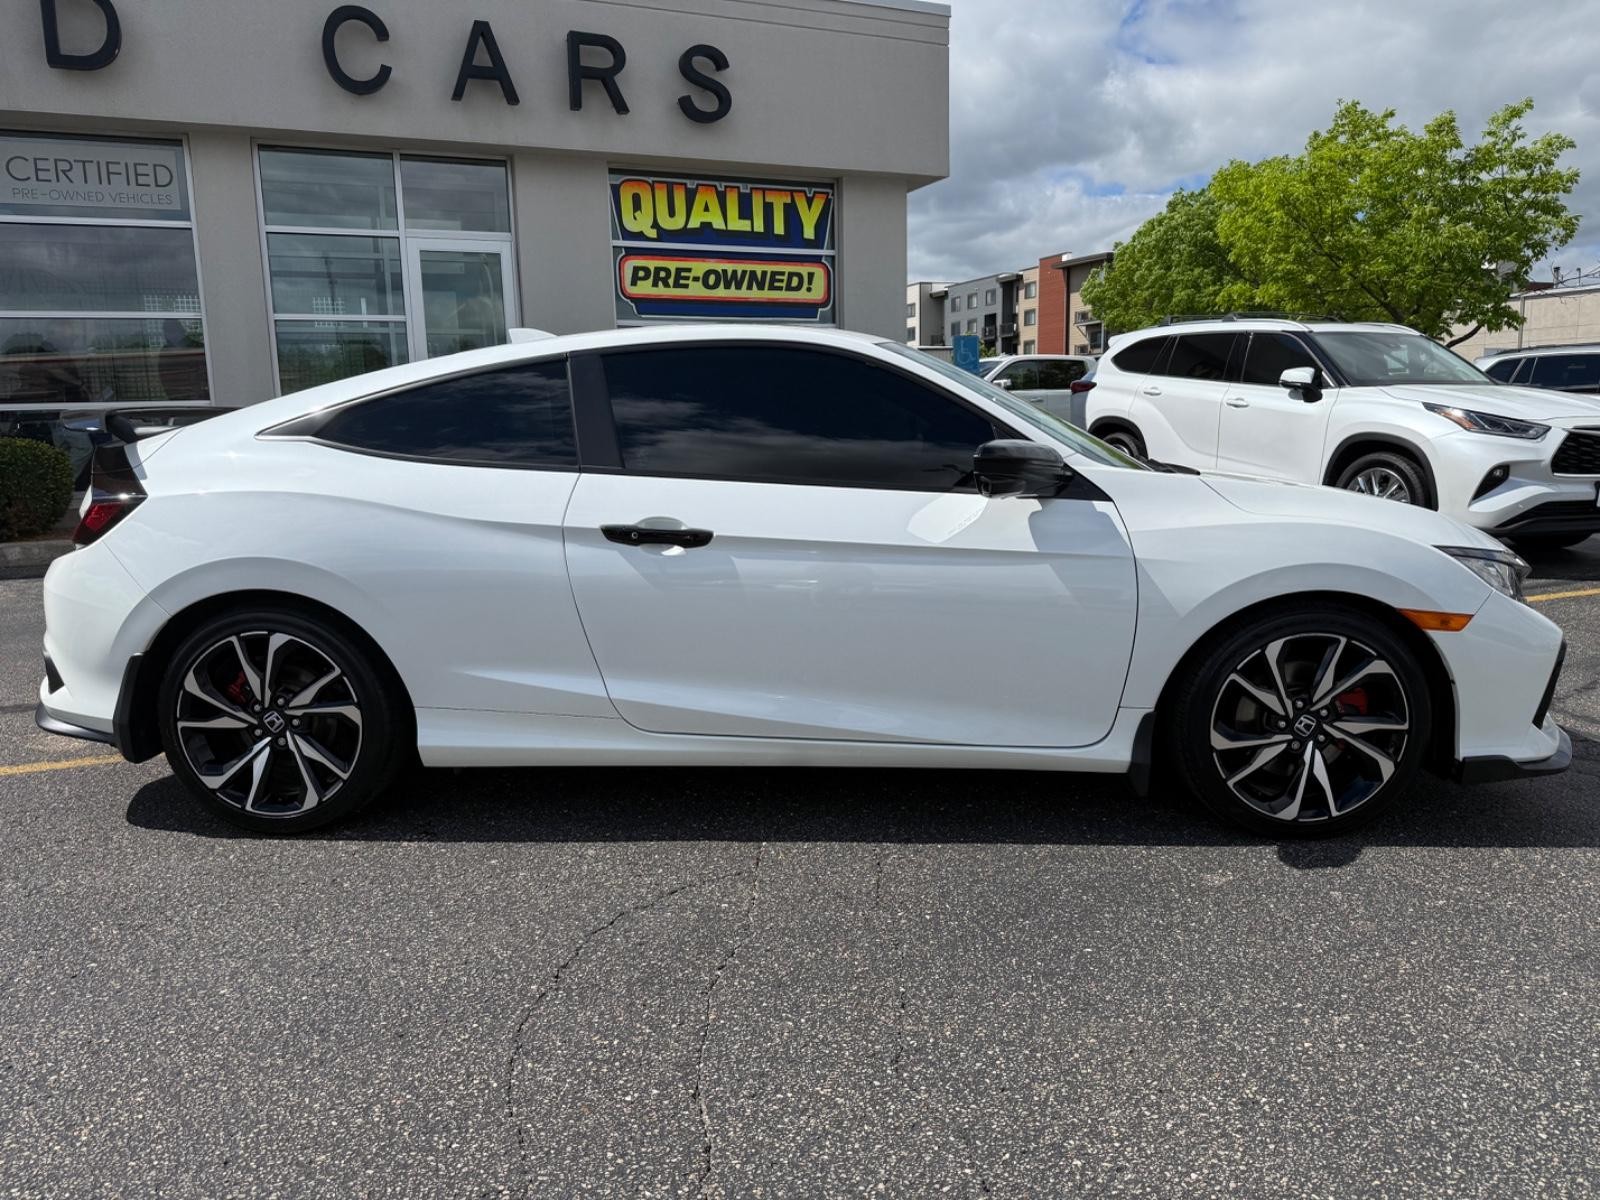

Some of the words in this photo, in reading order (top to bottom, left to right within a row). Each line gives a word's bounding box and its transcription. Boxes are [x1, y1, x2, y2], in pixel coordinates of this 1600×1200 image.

[321, 5, 733, 123] CARS
[6, 156, 173, 188] CERTIFIED
[12, 188, 104, 203] PRE-OWNED
[110, 192, 173, 205] VEHICLES
[619, 179, 830, 240] QUALITY
[630, 265, 816, 293] PRE-OWNED!
